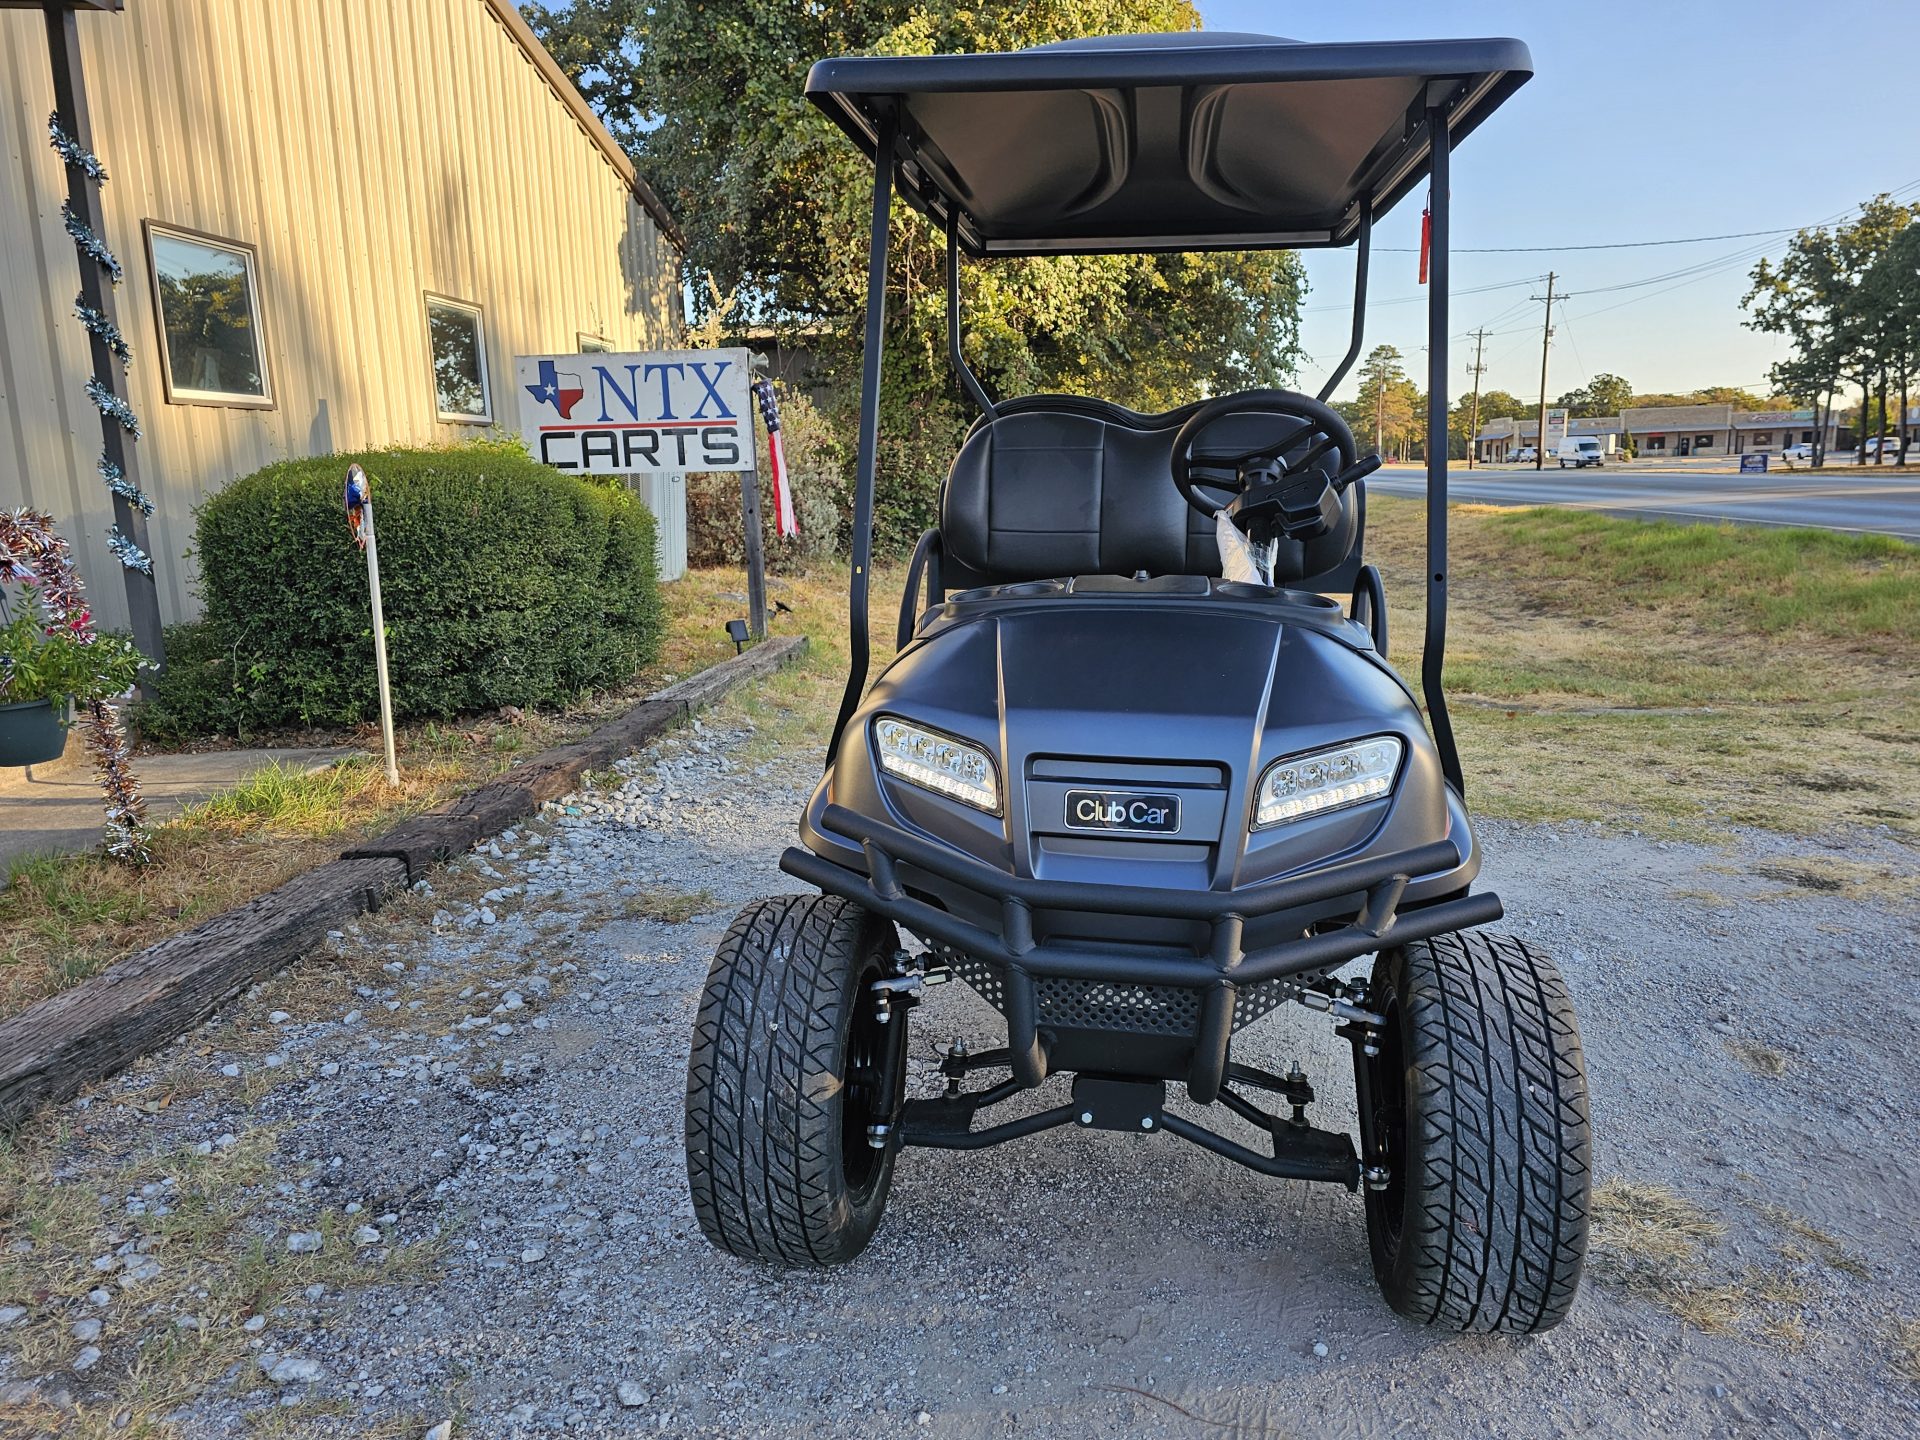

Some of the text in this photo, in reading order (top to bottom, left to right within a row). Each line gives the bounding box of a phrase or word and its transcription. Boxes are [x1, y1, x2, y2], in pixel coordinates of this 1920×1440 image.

[592, 361, 737, 422] NTX
[540, 427, 740, 469] CARTS
[1076, 799, 1169, 825] Club Car
